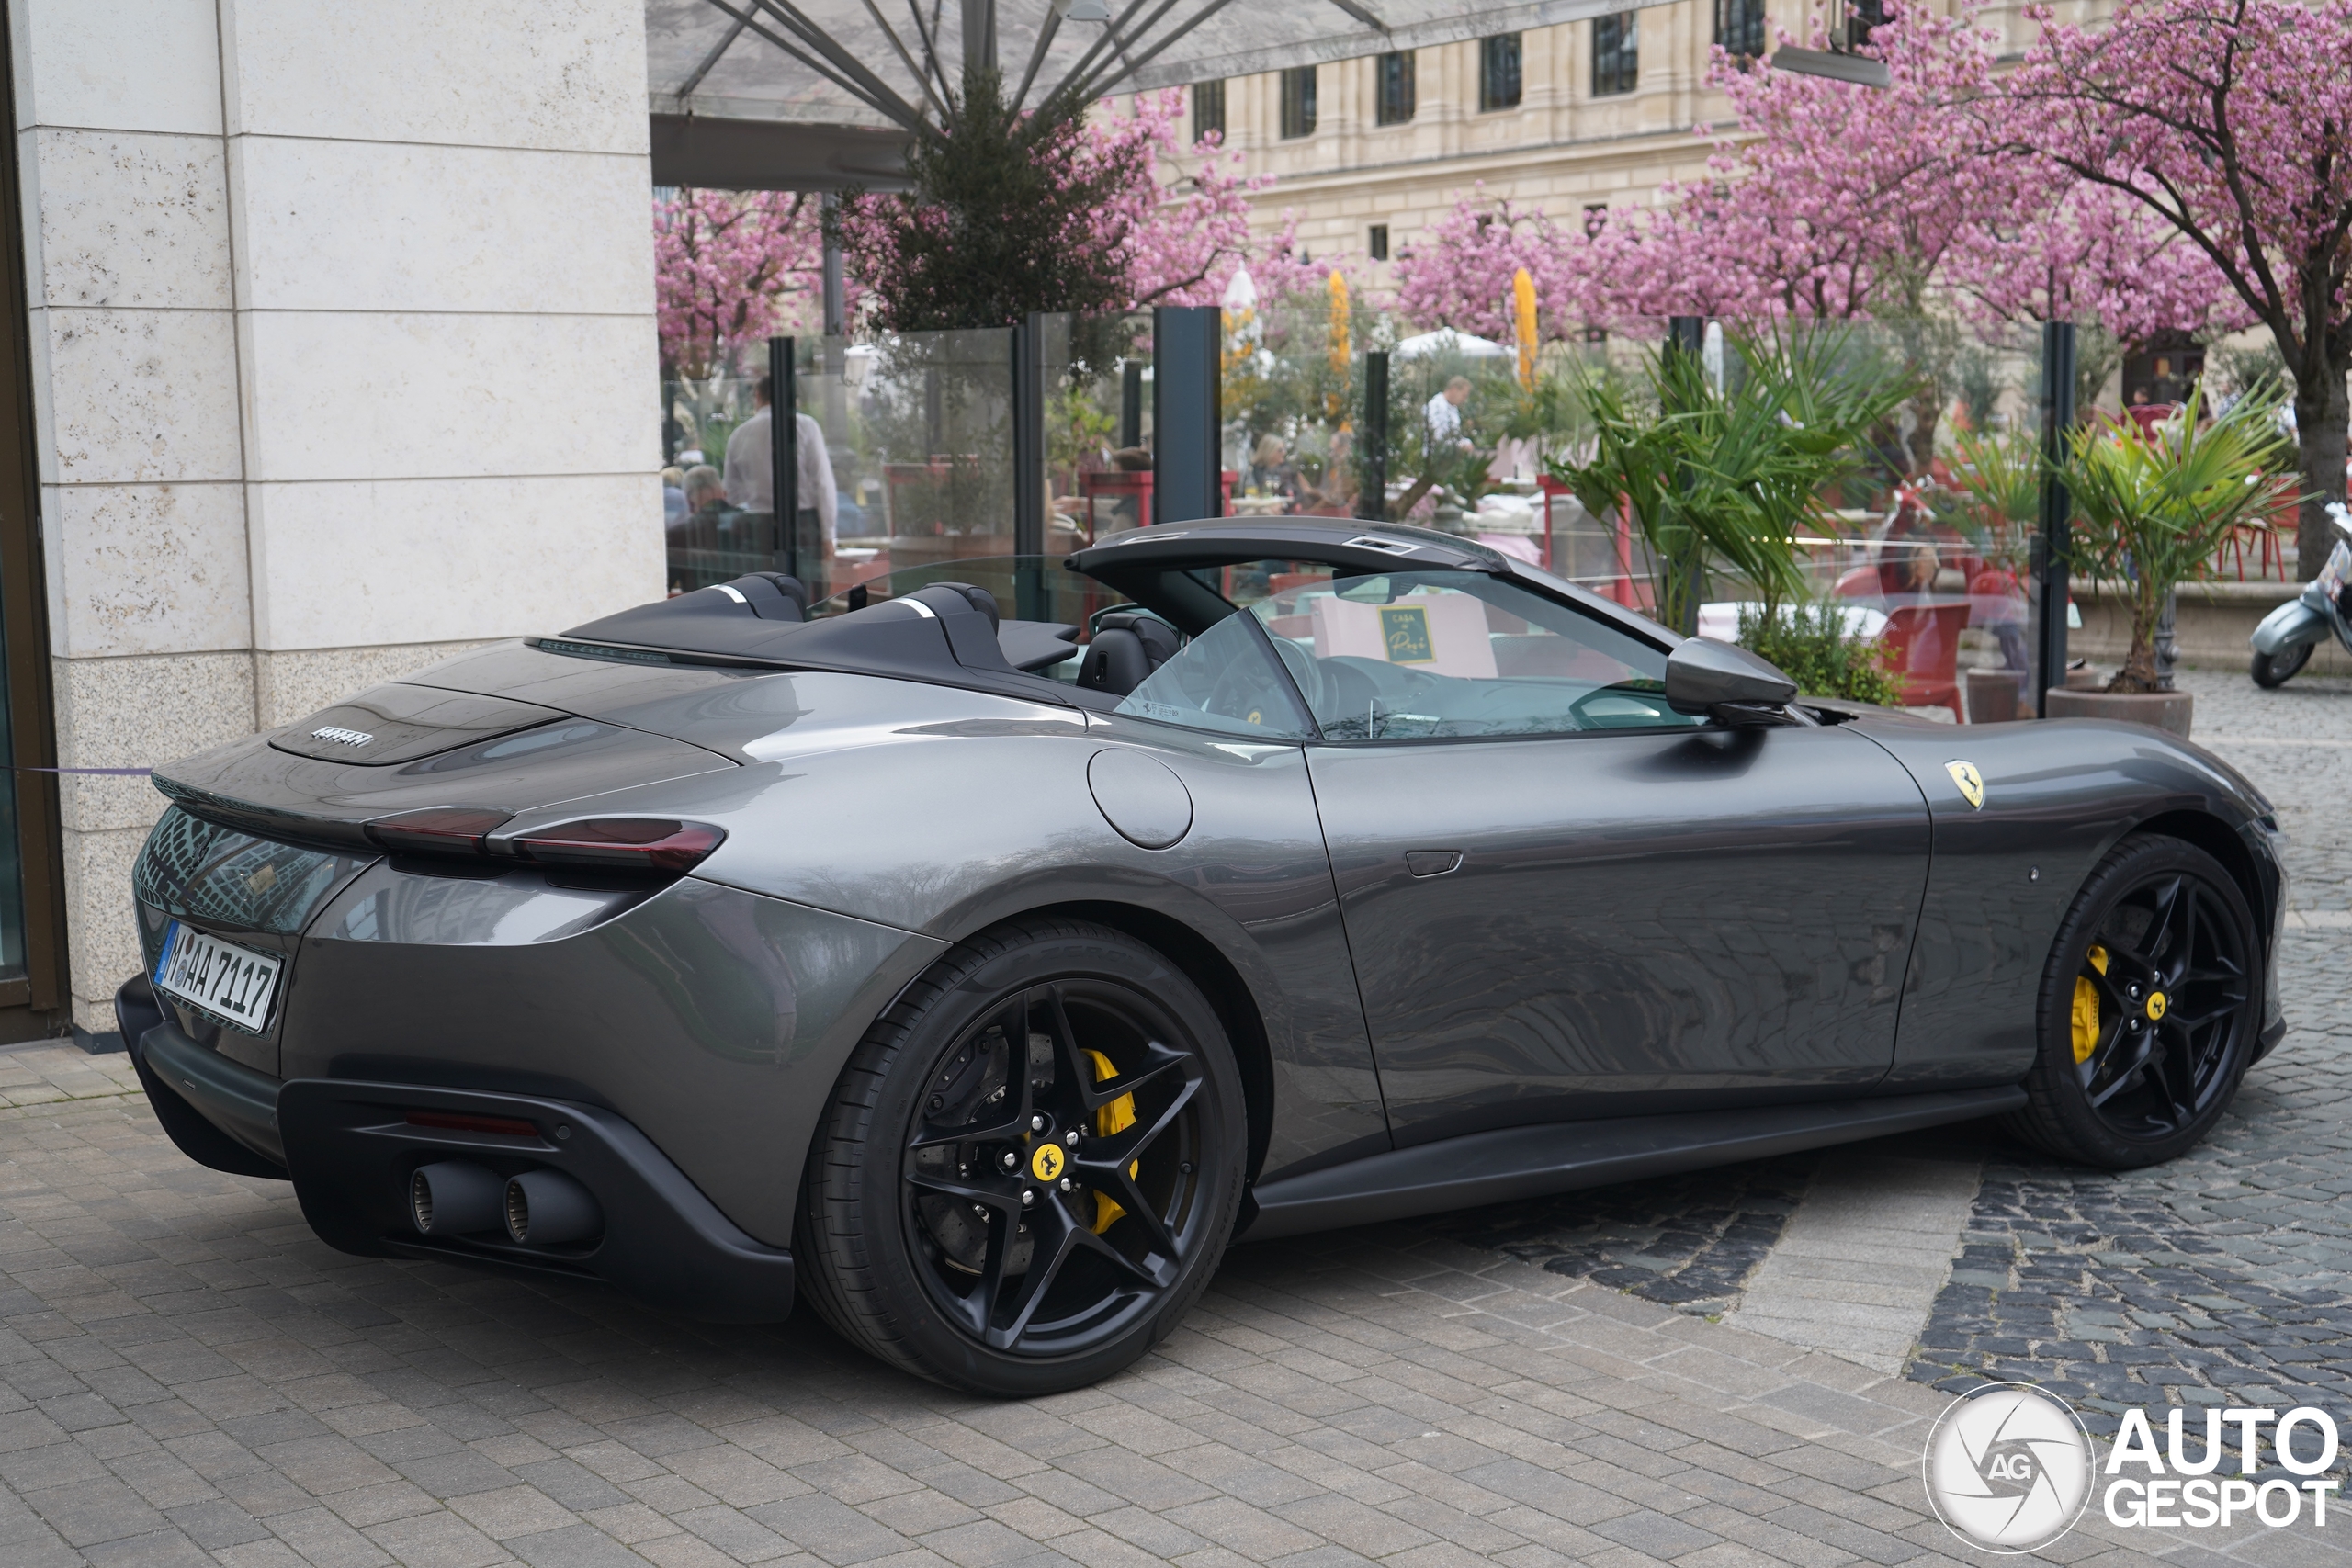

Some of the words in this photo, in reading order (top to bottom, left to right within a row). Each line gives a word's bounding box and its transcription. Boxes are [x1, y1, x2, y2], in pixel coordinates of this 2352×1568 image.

[164, 931, 187, 982] M
[182, 940, 215, 997] AA
[209, 950, 273, 1018] 7117
